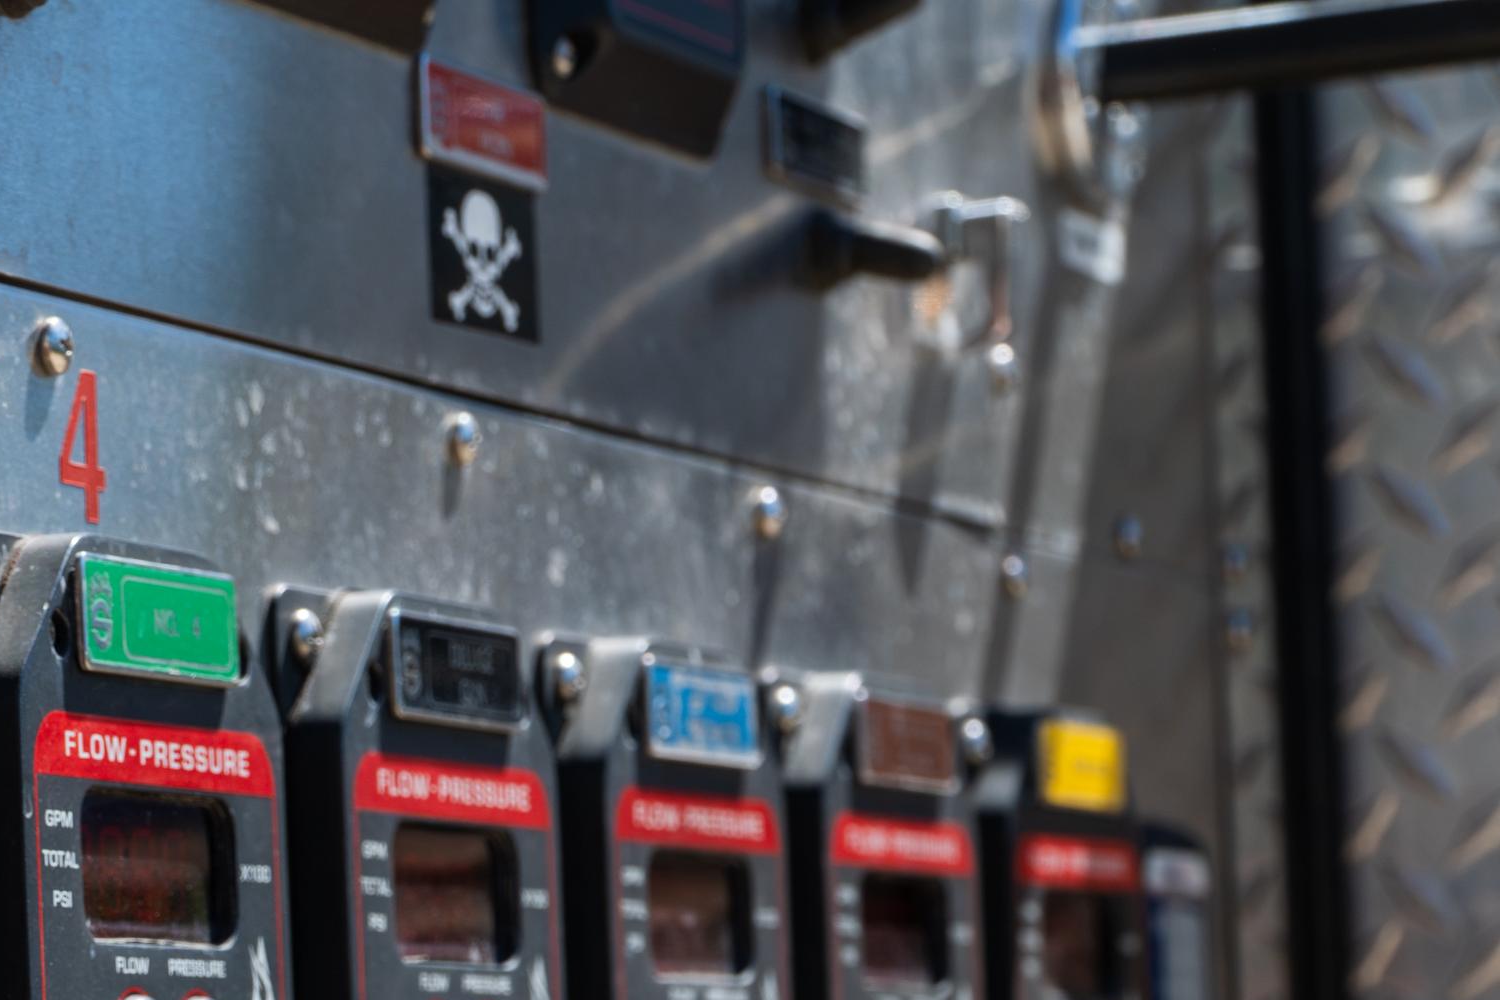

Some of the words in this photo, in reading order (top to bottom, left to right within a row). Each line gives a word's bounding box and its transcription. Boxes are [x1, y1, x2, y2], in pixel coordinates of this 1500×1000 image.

[59, 369, 106, 524] 4
[45, 809, 73, 828] GPM
[42, 850, 79, 870] TOTAL
[53, 890, 73, 908] PSI
[116, 957, 149, 975] FLOW
[168, 958, 226, 979] PRESSURE
